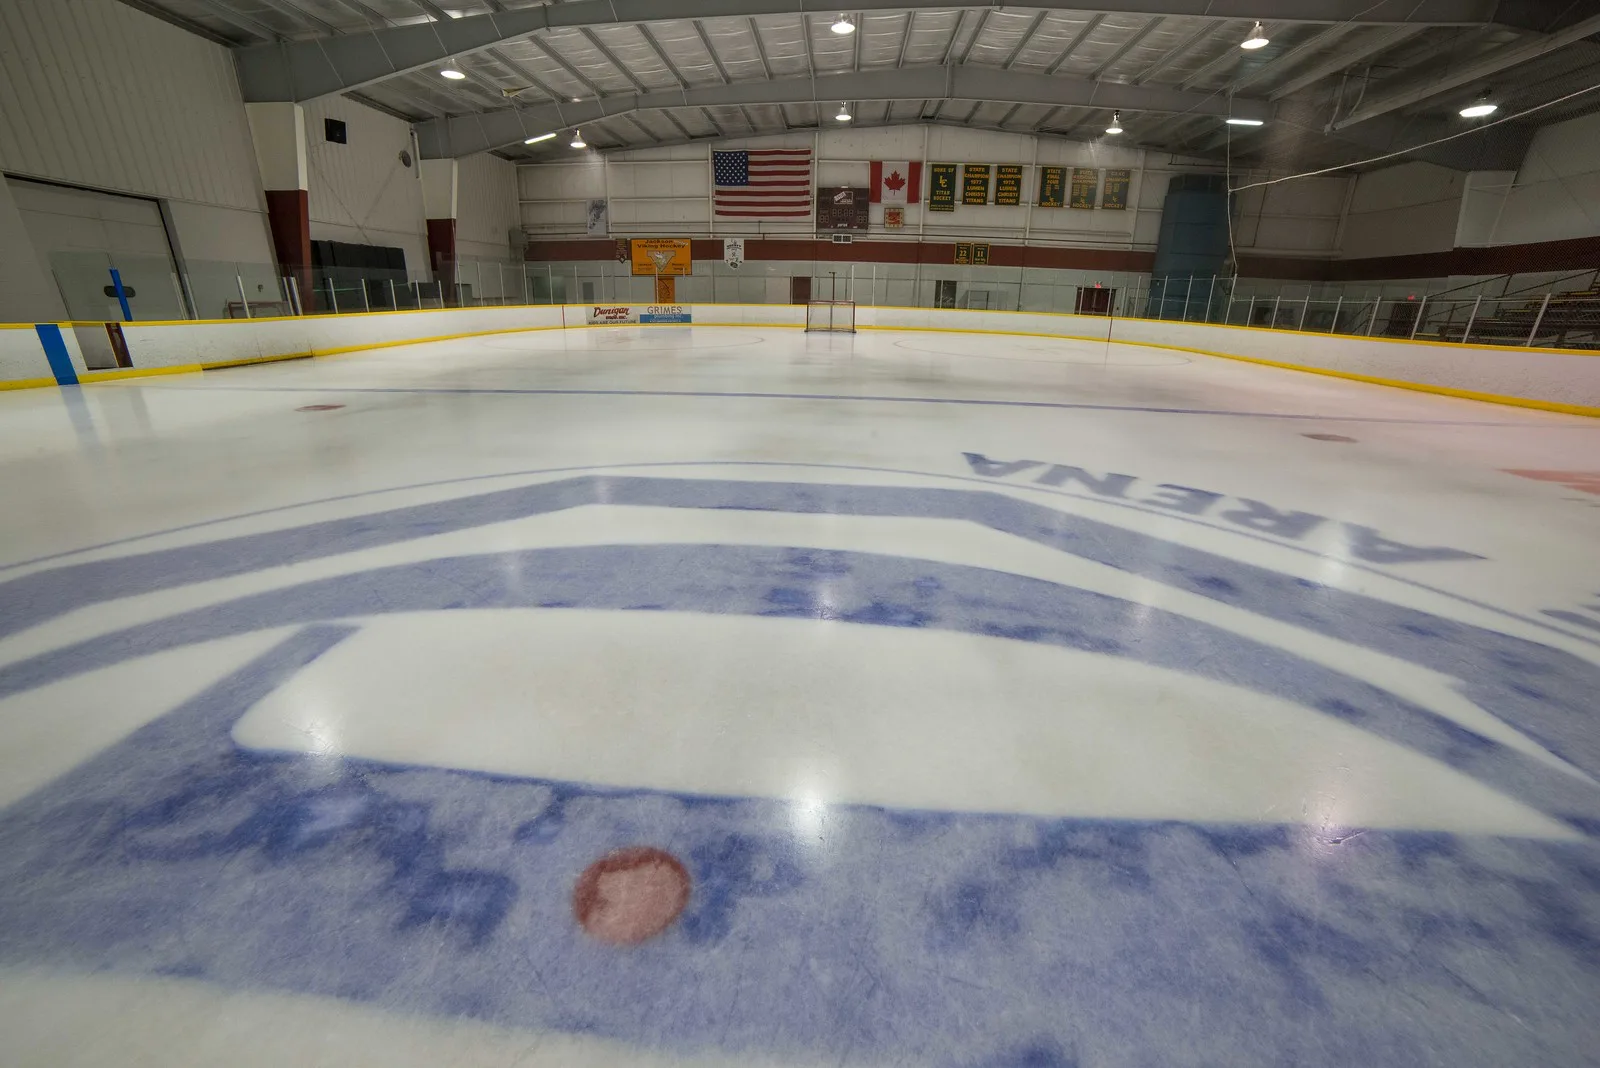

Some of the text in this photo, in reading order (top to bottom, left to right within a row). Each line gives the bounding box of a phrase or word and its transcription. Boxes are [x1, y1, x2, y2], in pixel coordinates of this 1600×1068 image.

[594, 306, 630, 318] Dunigan
[647, 306, 682, 314] GRIMES
[962, 451, 1489, 564] ARENA
